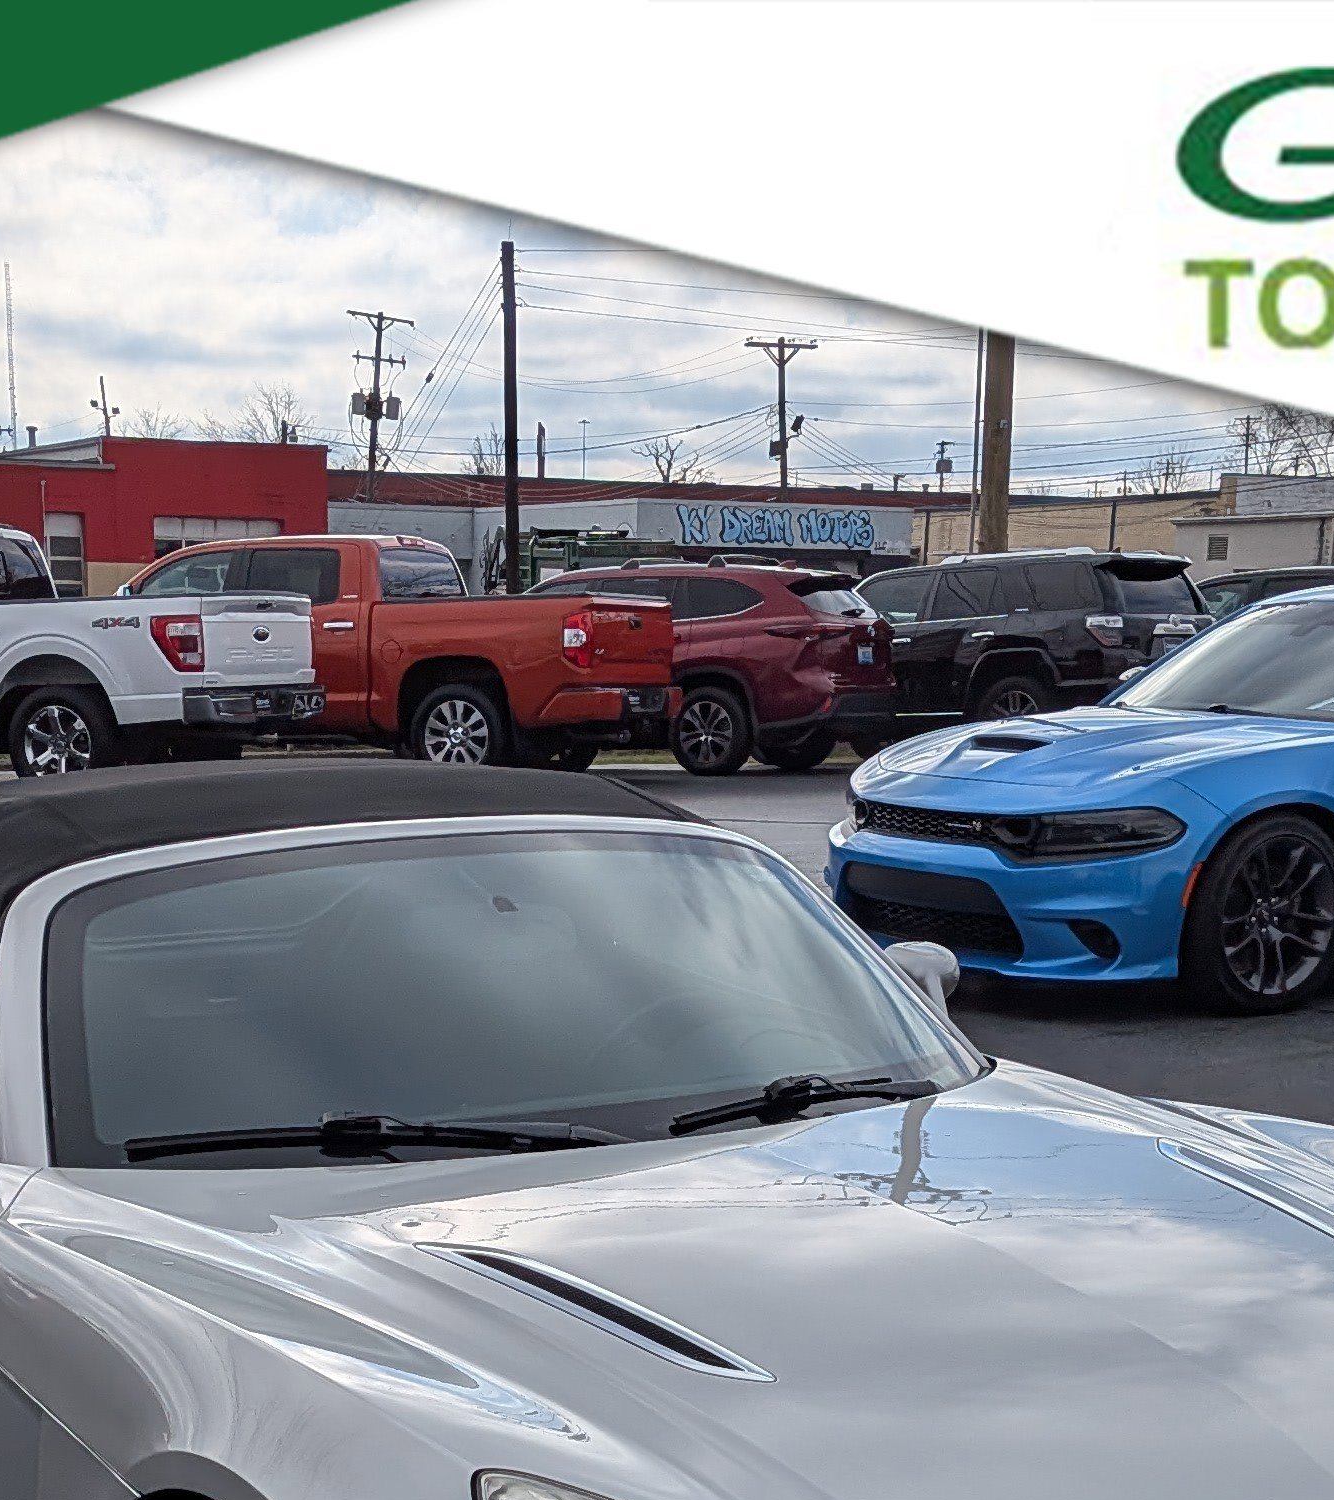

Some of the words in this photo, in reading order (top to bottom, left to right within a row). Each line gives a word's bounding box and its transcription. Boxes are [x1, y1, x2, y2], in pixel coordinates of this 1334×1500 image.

[676, 503, 714, 545] KY
[719, 505, 795, 547] DREAM
[797, 508, 874, 550] MOTORS
